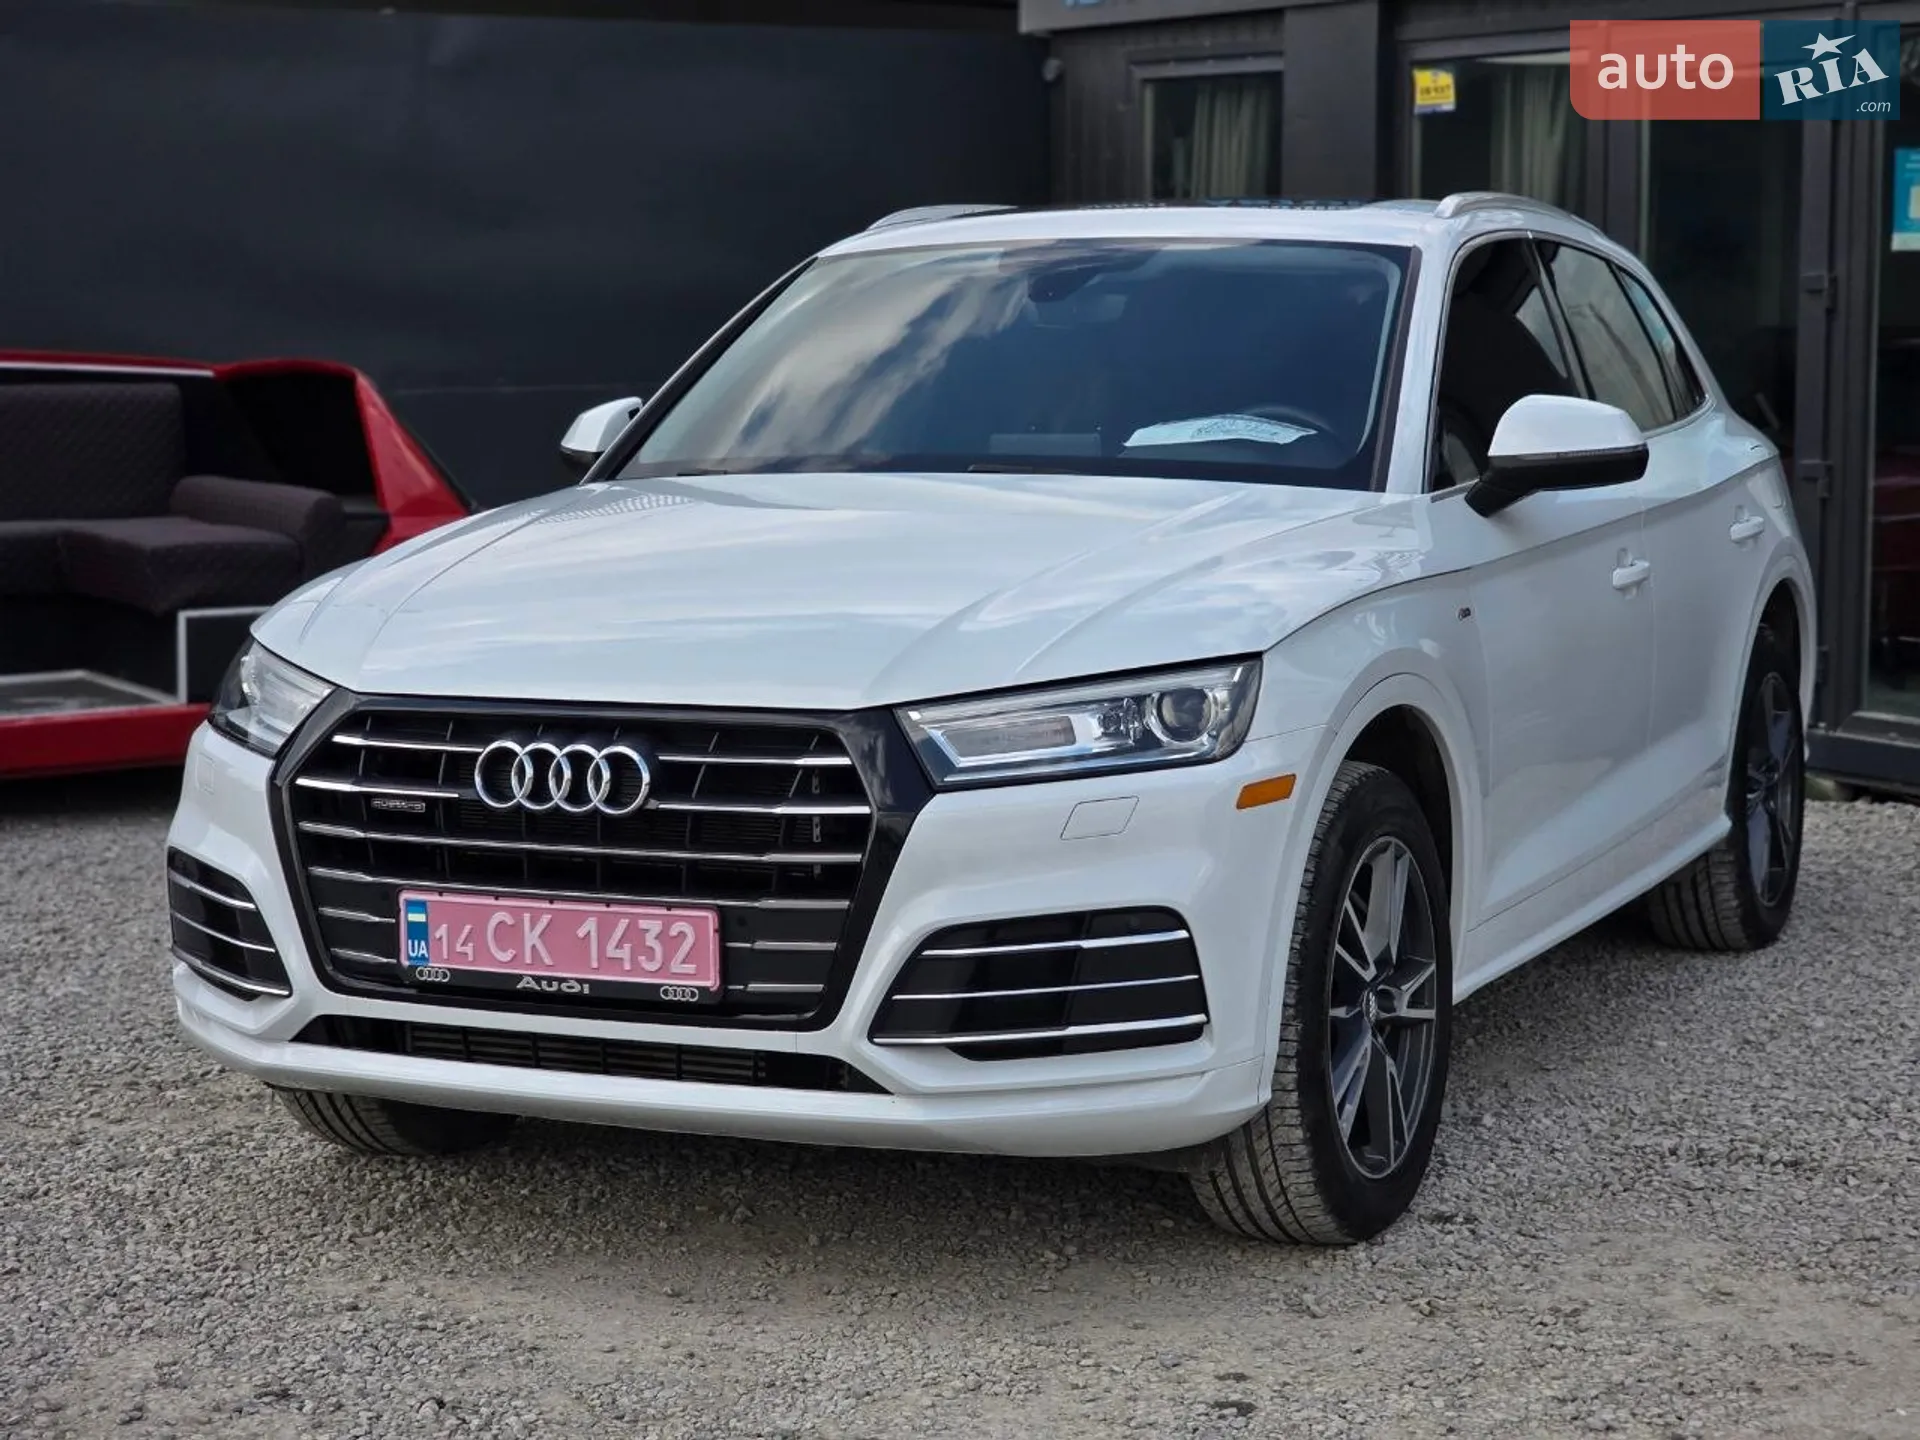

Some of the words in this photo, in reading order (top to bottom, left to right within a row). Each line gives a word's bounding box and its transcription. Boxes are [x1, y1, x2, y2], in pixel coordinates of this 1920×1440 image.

[408, 939, 428, 958] UA
[434, 923, 474, 961] 14
[486, 912, 553, 966] CK
[576, 917, 697, 975] 1432
[516, 975, 590, 994] Audi
